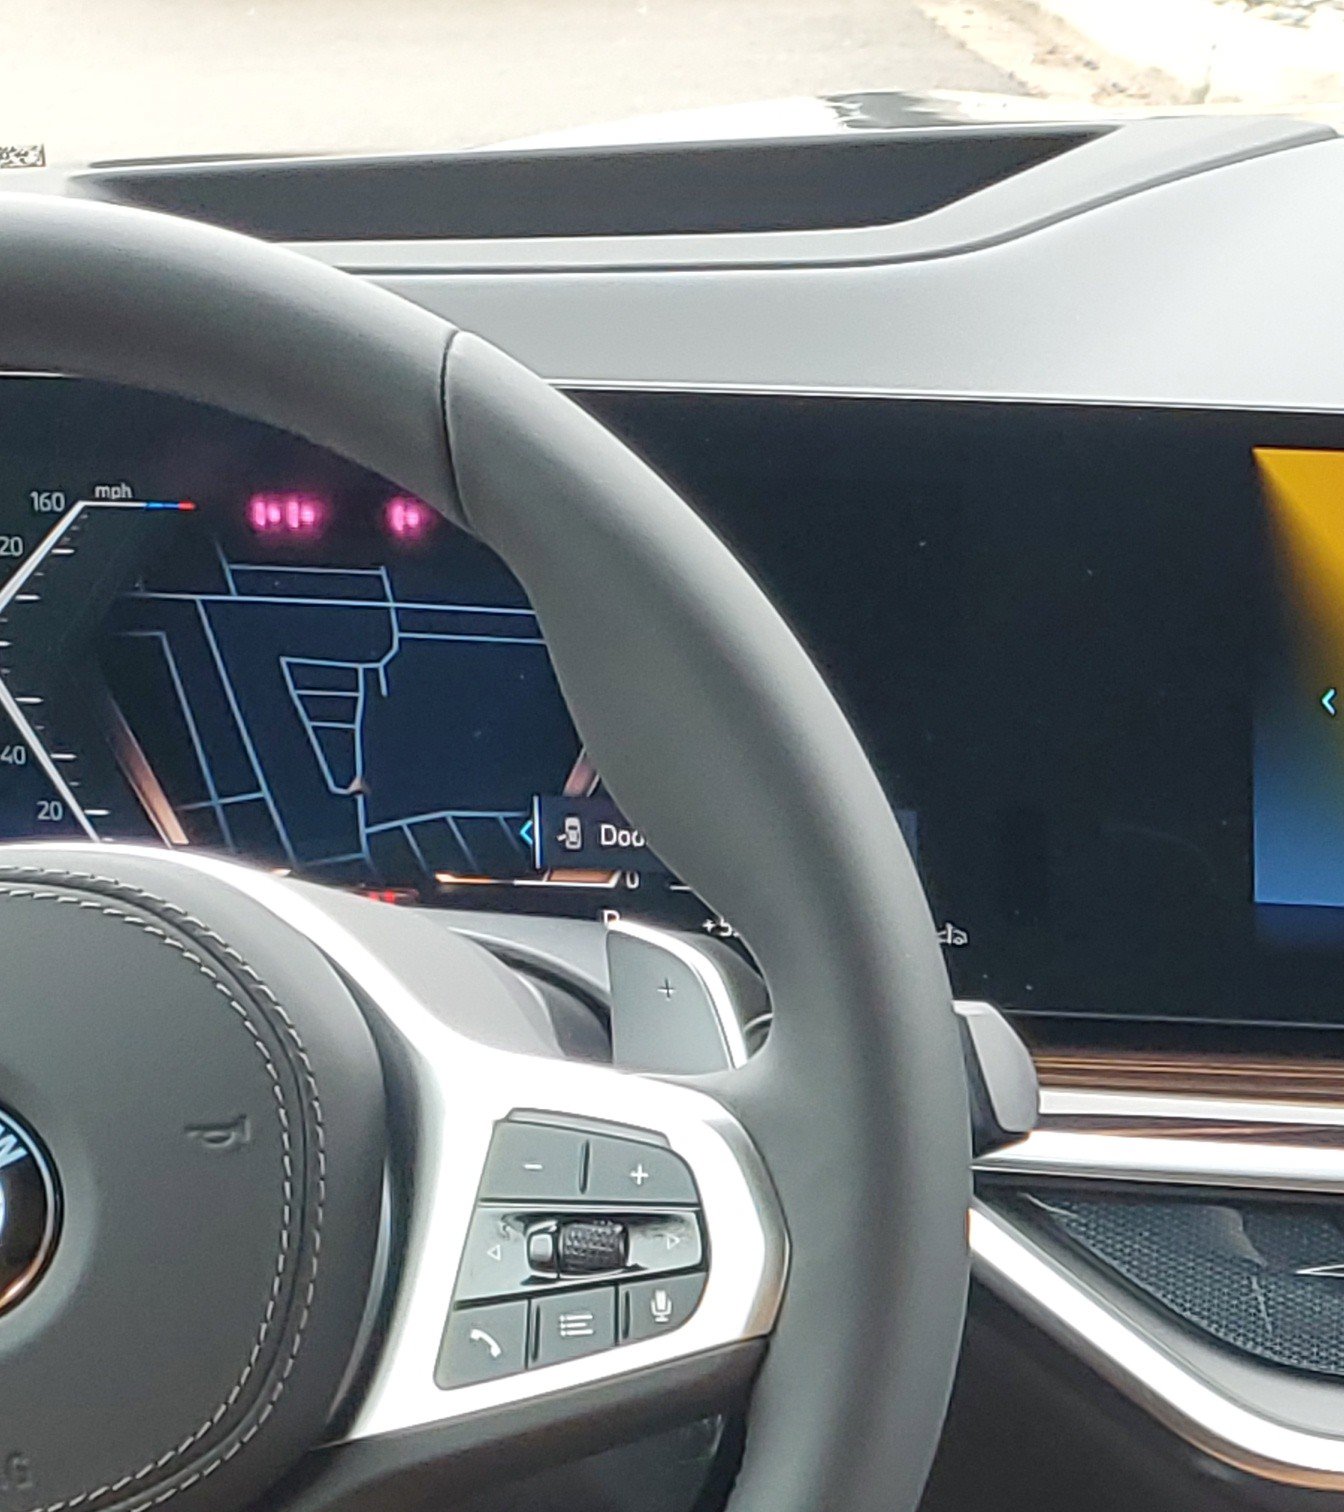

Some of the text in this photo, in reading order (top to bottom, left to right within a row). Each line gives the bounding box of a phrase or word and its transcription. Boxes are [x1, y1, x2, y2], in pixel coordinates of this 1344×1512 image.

[94, 483, 133, 499] mph
[30, 491, 65, 512] 160
[37, 801, 63, 821] 20
